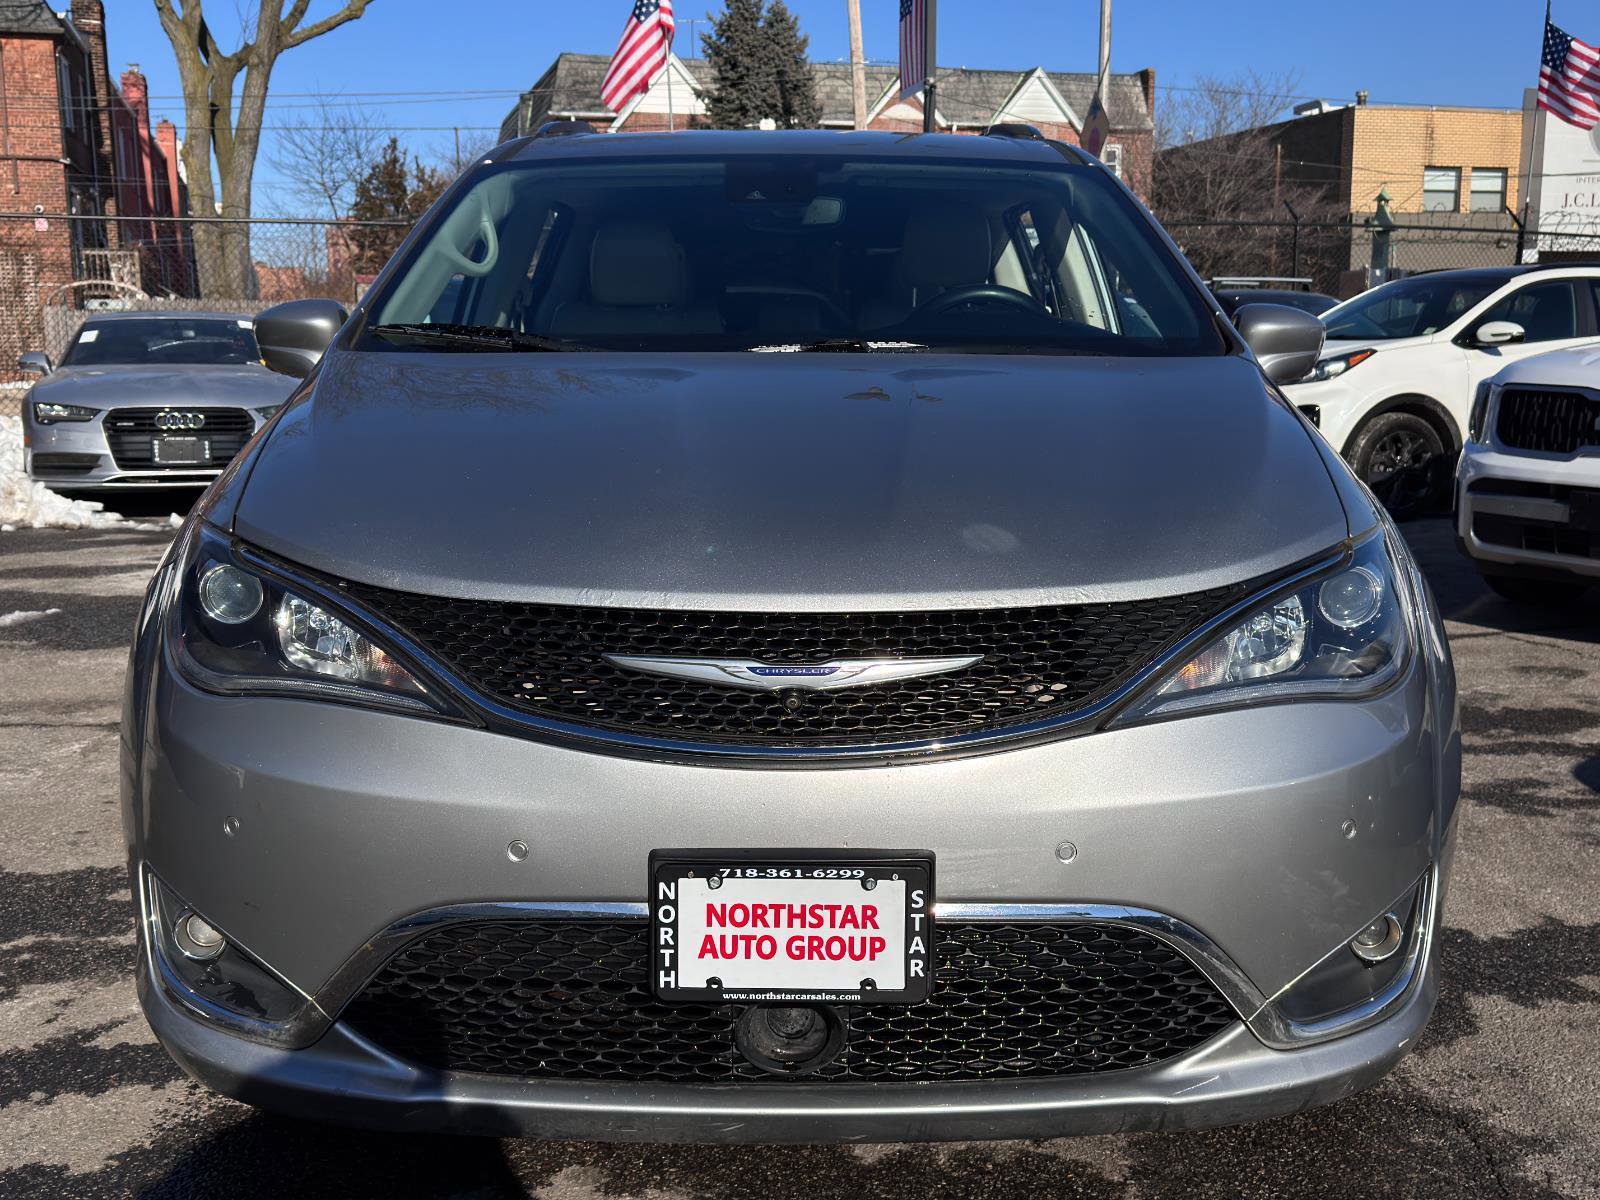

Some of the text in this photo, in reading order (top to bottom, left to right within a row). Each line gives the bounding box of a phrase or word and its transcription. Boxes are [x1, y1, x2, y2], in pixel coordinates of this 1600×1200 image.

[720, 869, 865, 878] 718-361-6299
[706, 903, 879, 929] NORTHSTAR
[658, 882, 675, 988] NORTH
[909, 890, 925, 977] STAR
[698, 934, 886, 961] AUTO GROUP
[722, 992, 861, 1001] www.northstarcarsales.com
